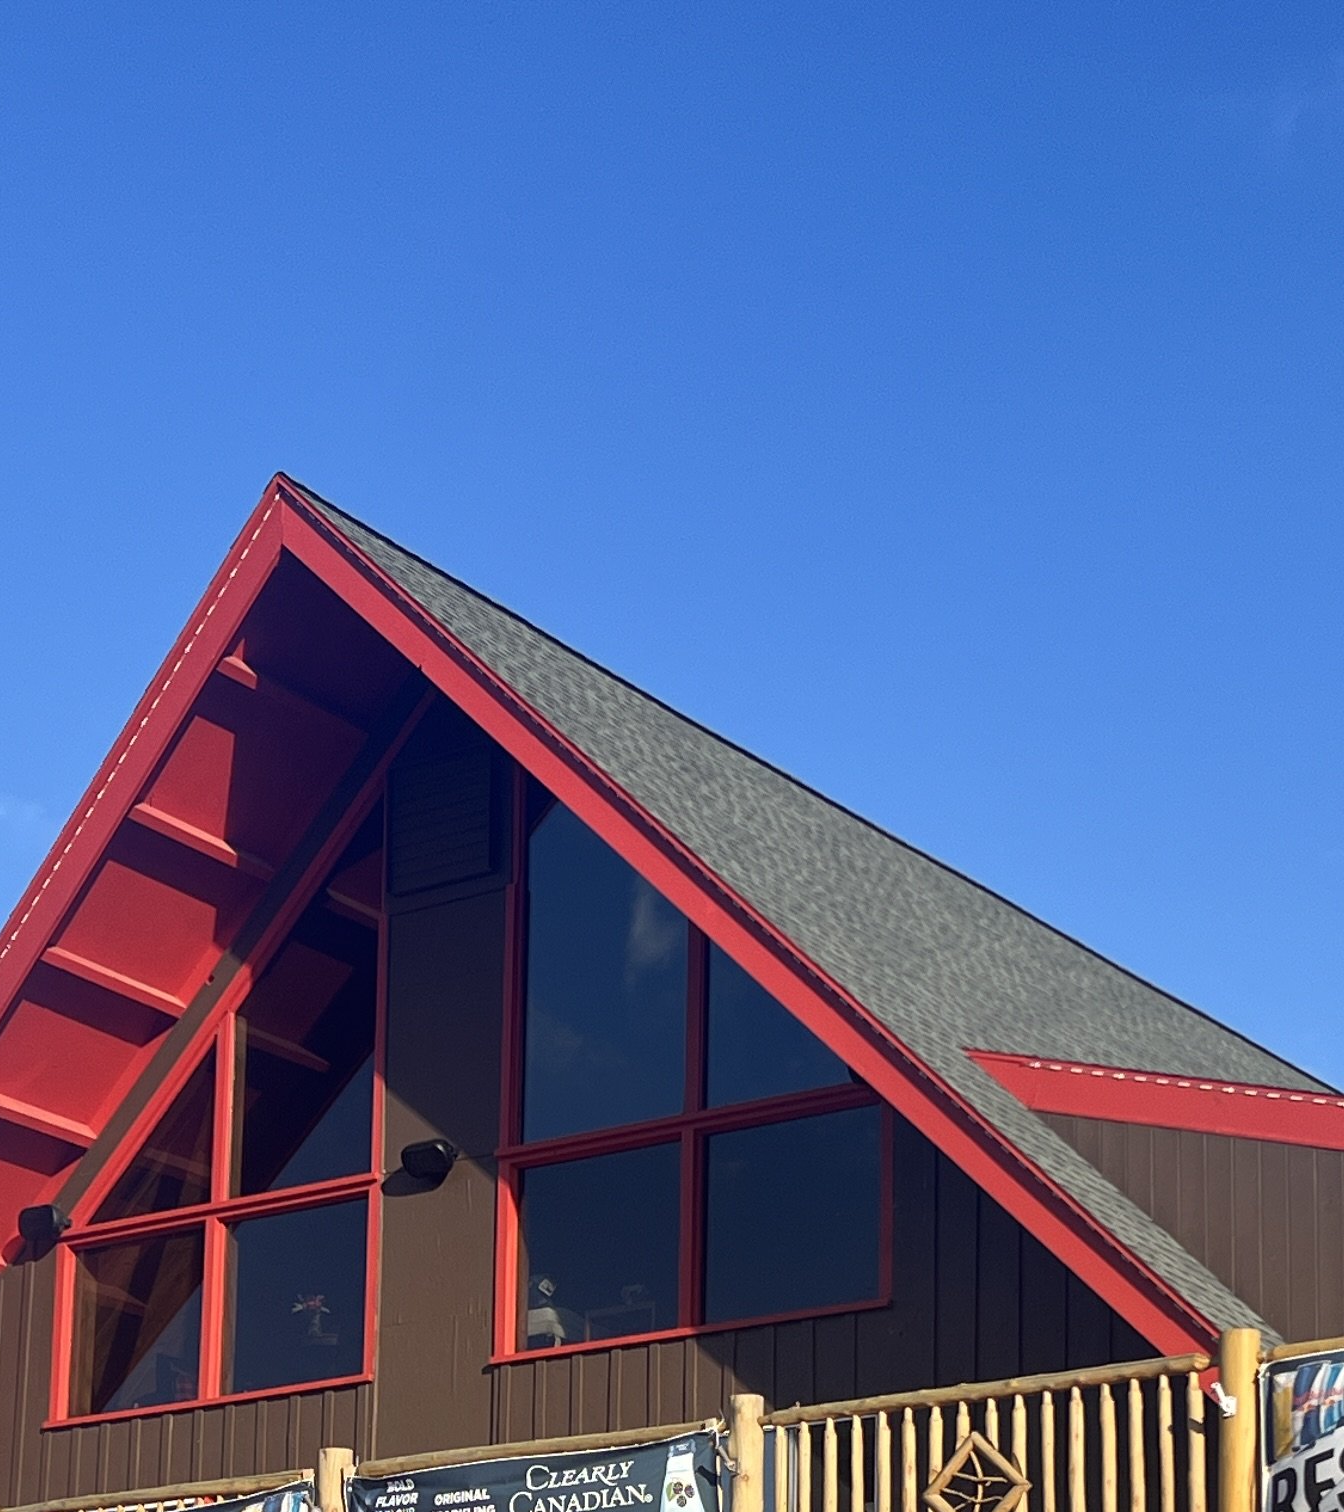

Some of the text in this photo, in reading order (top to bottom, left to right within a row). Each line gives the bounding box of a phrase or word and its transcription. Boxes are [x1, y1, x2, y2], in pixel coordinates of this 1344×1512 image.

[386, 1478, 415, 1493] BOLD
[375, 1492, 418, 1508] FLAVOR
[433, 1488, 491, 1506] ORIGINAL
